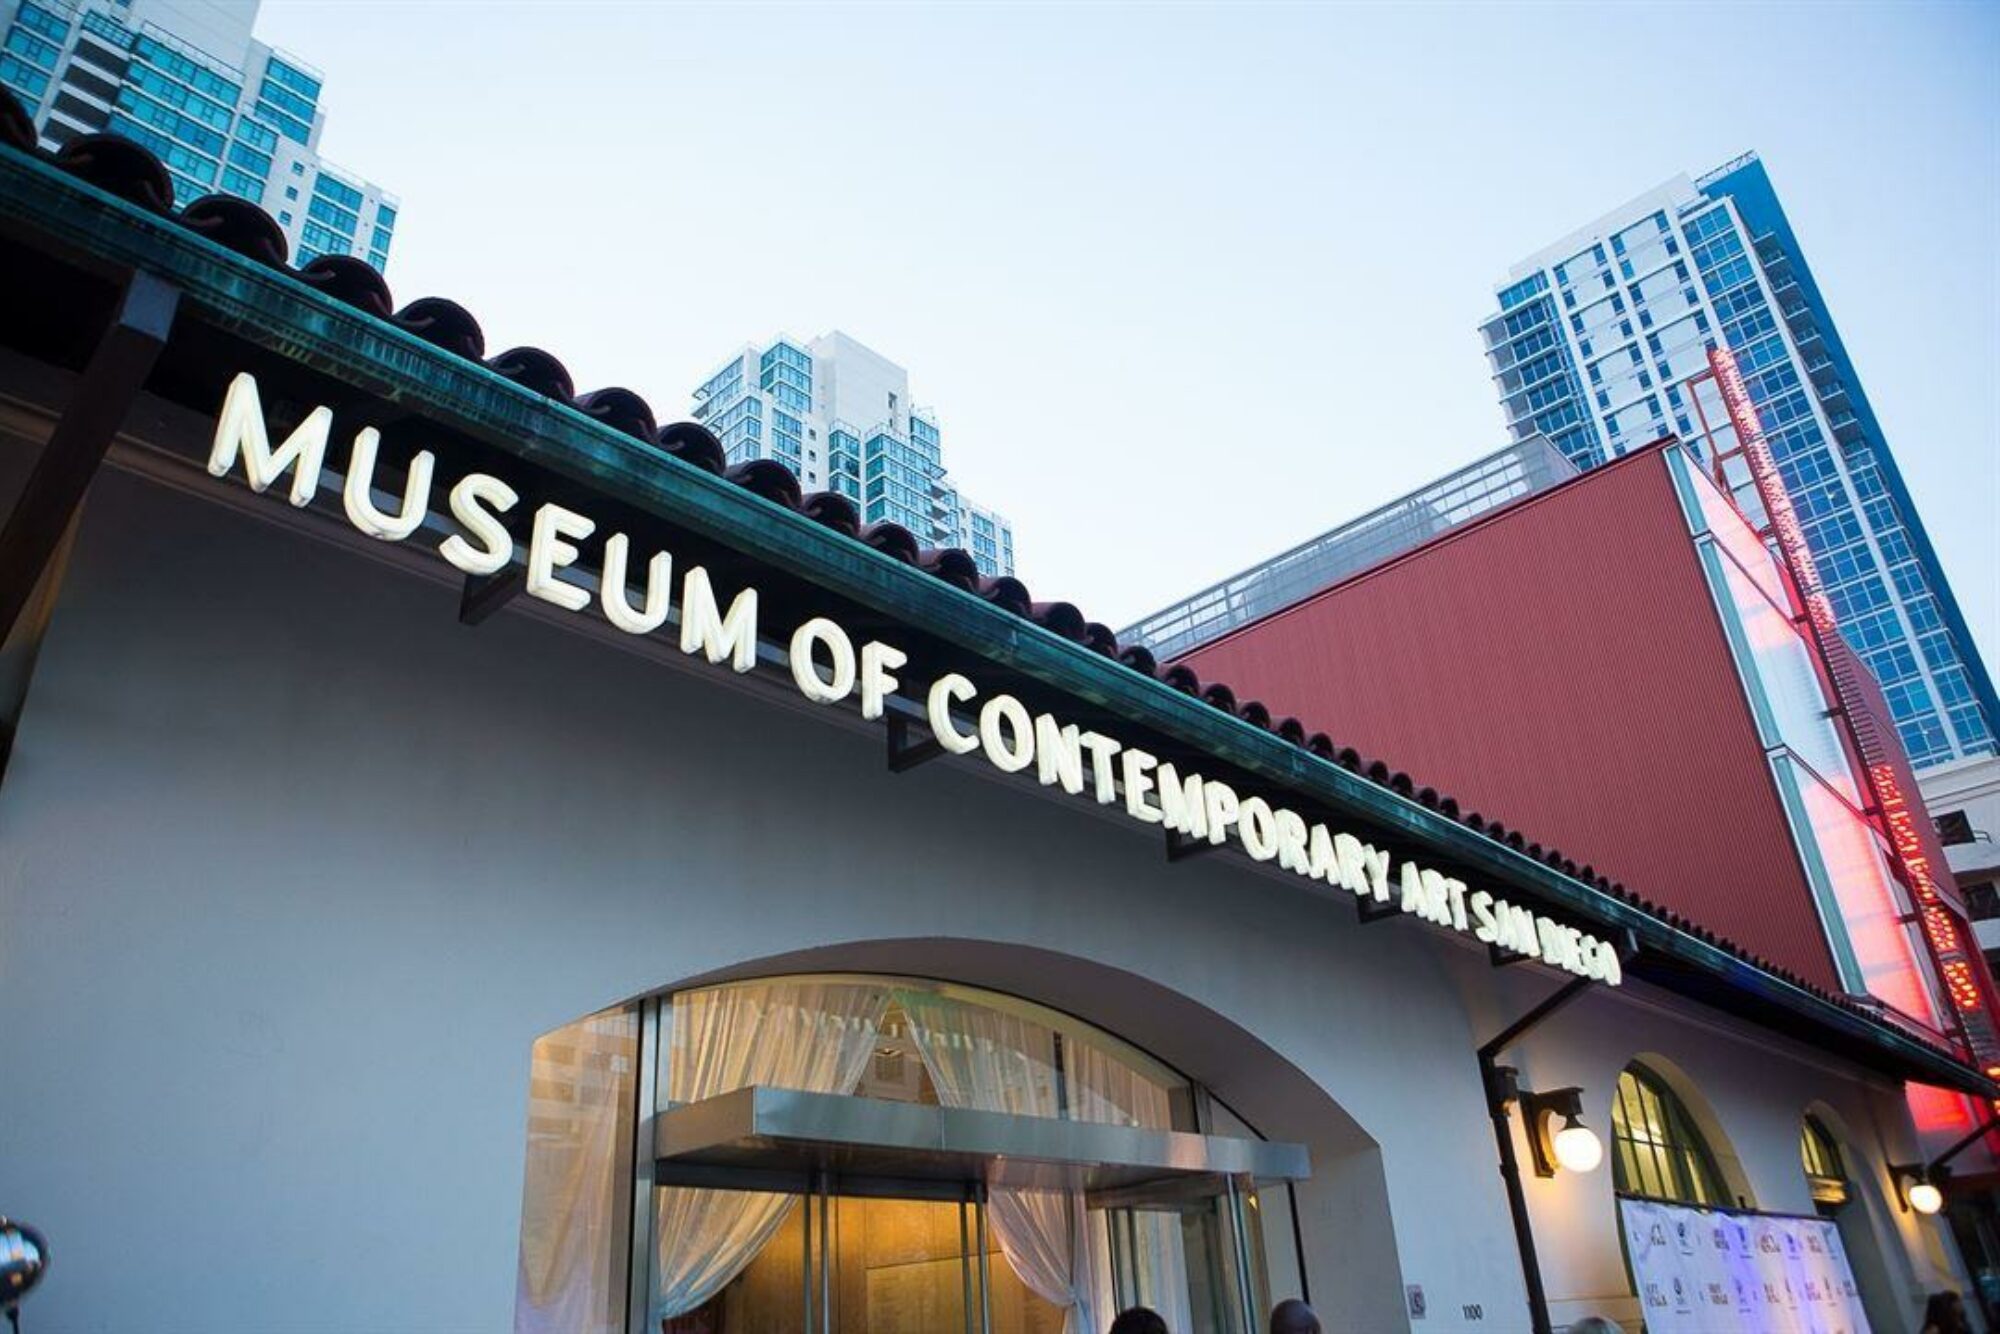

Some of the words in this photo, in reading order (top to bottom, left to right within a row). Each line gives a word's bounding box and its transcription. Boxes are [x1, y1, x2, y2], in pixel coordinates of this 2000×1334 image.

[207, 371, 758, 674] MUSEUM
[789, 617, 908, 720] OF
[927, 673, 1391, 902] CONTEMPORARY
[1401, 861, 1469, 931] ART
[1470, 890, 1541, 957] SAN
[1536, 916, 1622, 987] DIEGO
